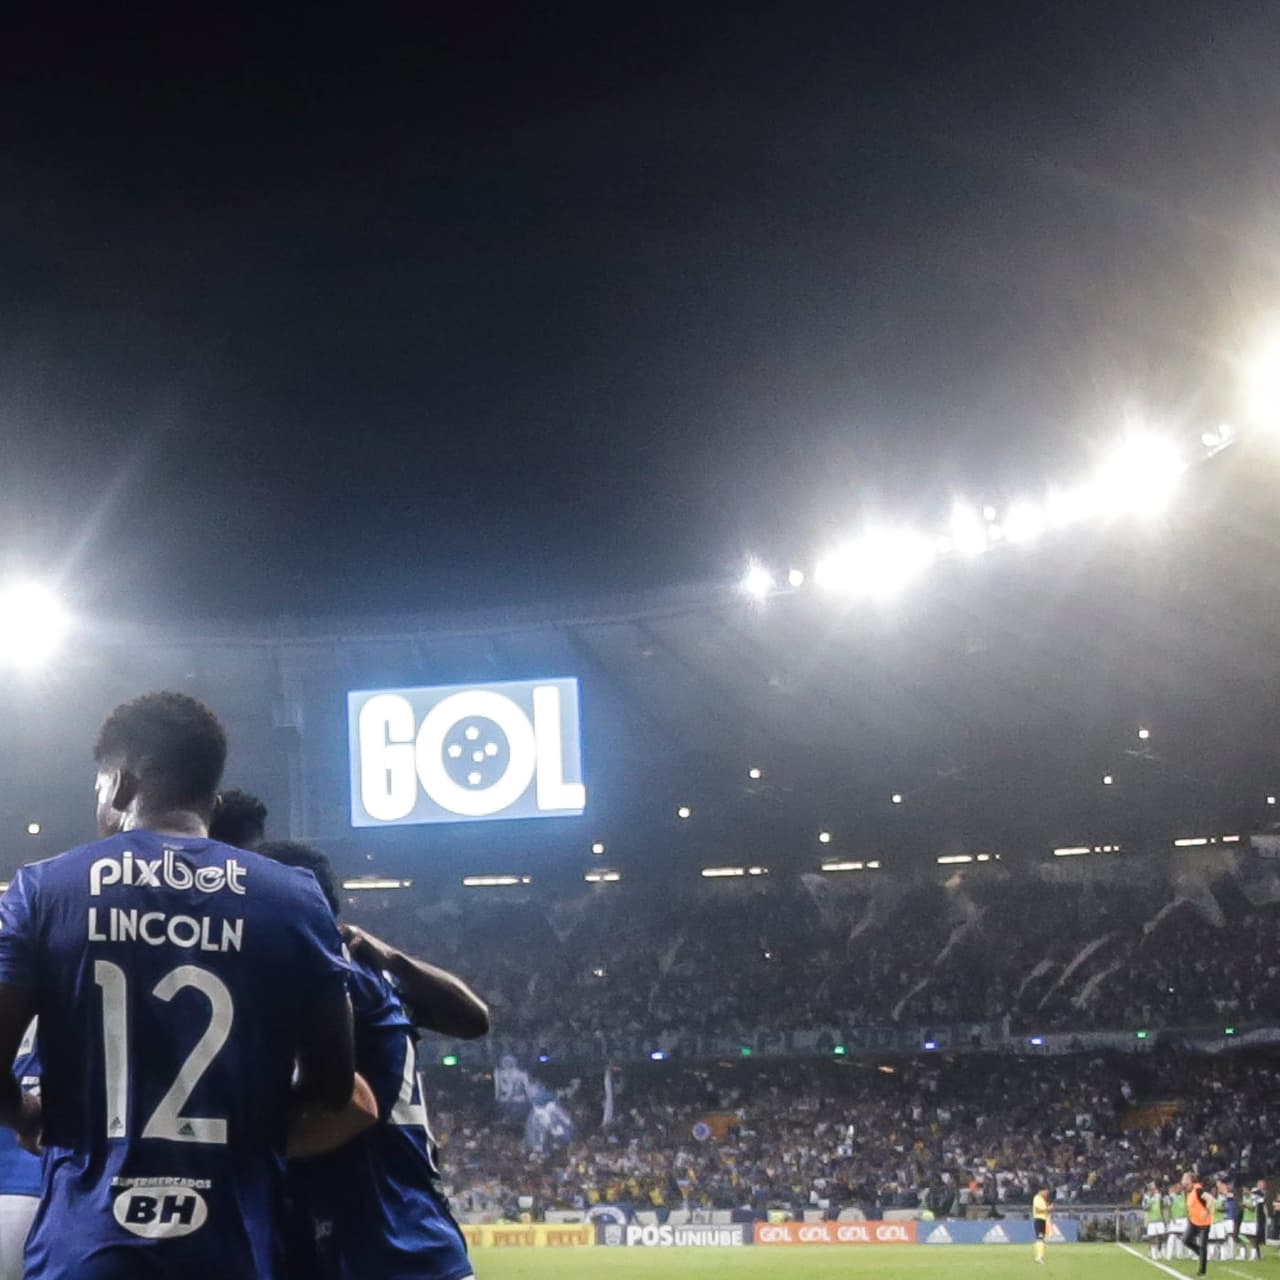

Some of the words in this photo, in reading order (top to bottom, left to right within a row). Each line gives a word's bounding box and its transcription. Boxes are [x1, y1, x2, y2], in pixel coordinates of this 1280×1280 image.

[359, 686, 585, 820] GOL
[90, 850, 247, 895] pixbet
[88, 907, 244, 952] LINCOLN
[95, 960, 234, 1144] 12
[125, 1196, 197, 1225] BH
[675, 1230, 742, 1246] UNIUBE
[759, 1226, 792, 1242] GOL
[799, 1226, 830, 1242] GOL
[838, 1226, 869, 1241] GOL
[876, 1225, 908, 1241] GOL
